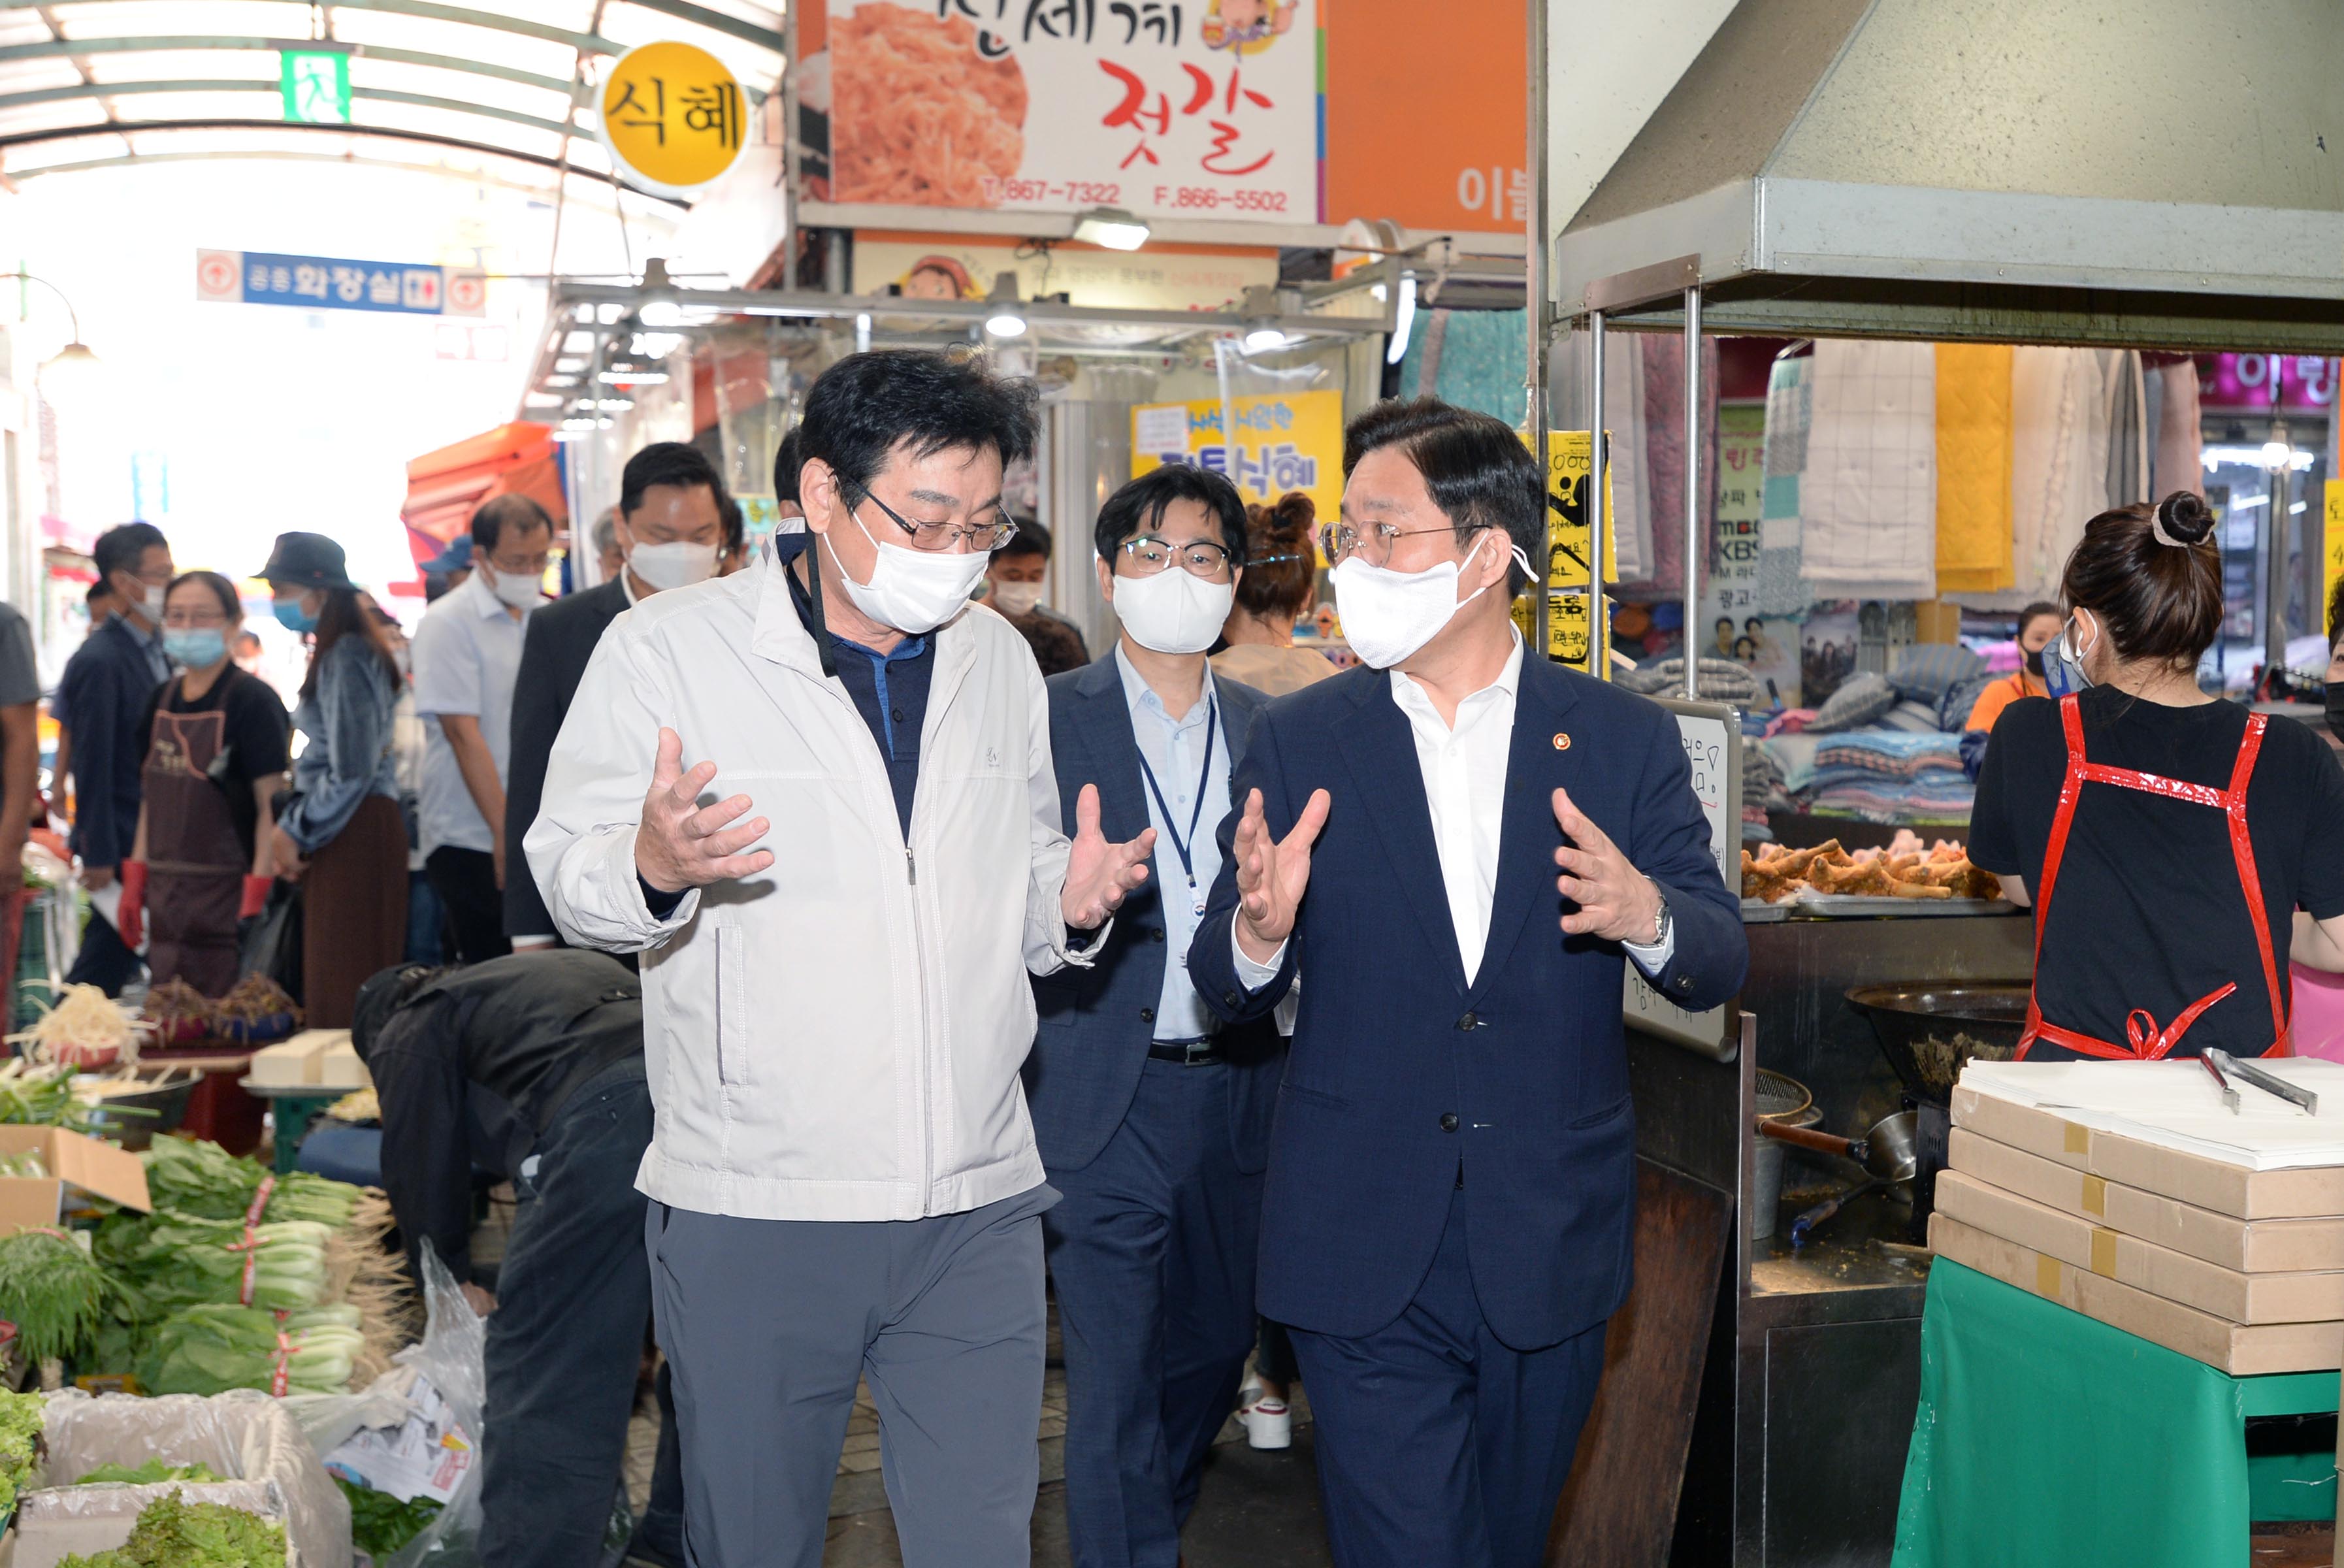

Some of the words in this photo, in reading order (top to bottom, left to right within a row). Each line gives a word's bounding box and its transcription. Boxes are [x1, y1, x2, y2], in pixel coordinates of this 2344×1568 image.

[608, 76, 737, 150] 식혜
[1098, 59, 1275, 176] 젓갈
[1154, 187, 1288, 212] F.866-5502
[294, 263, 401, 305] 화장실
